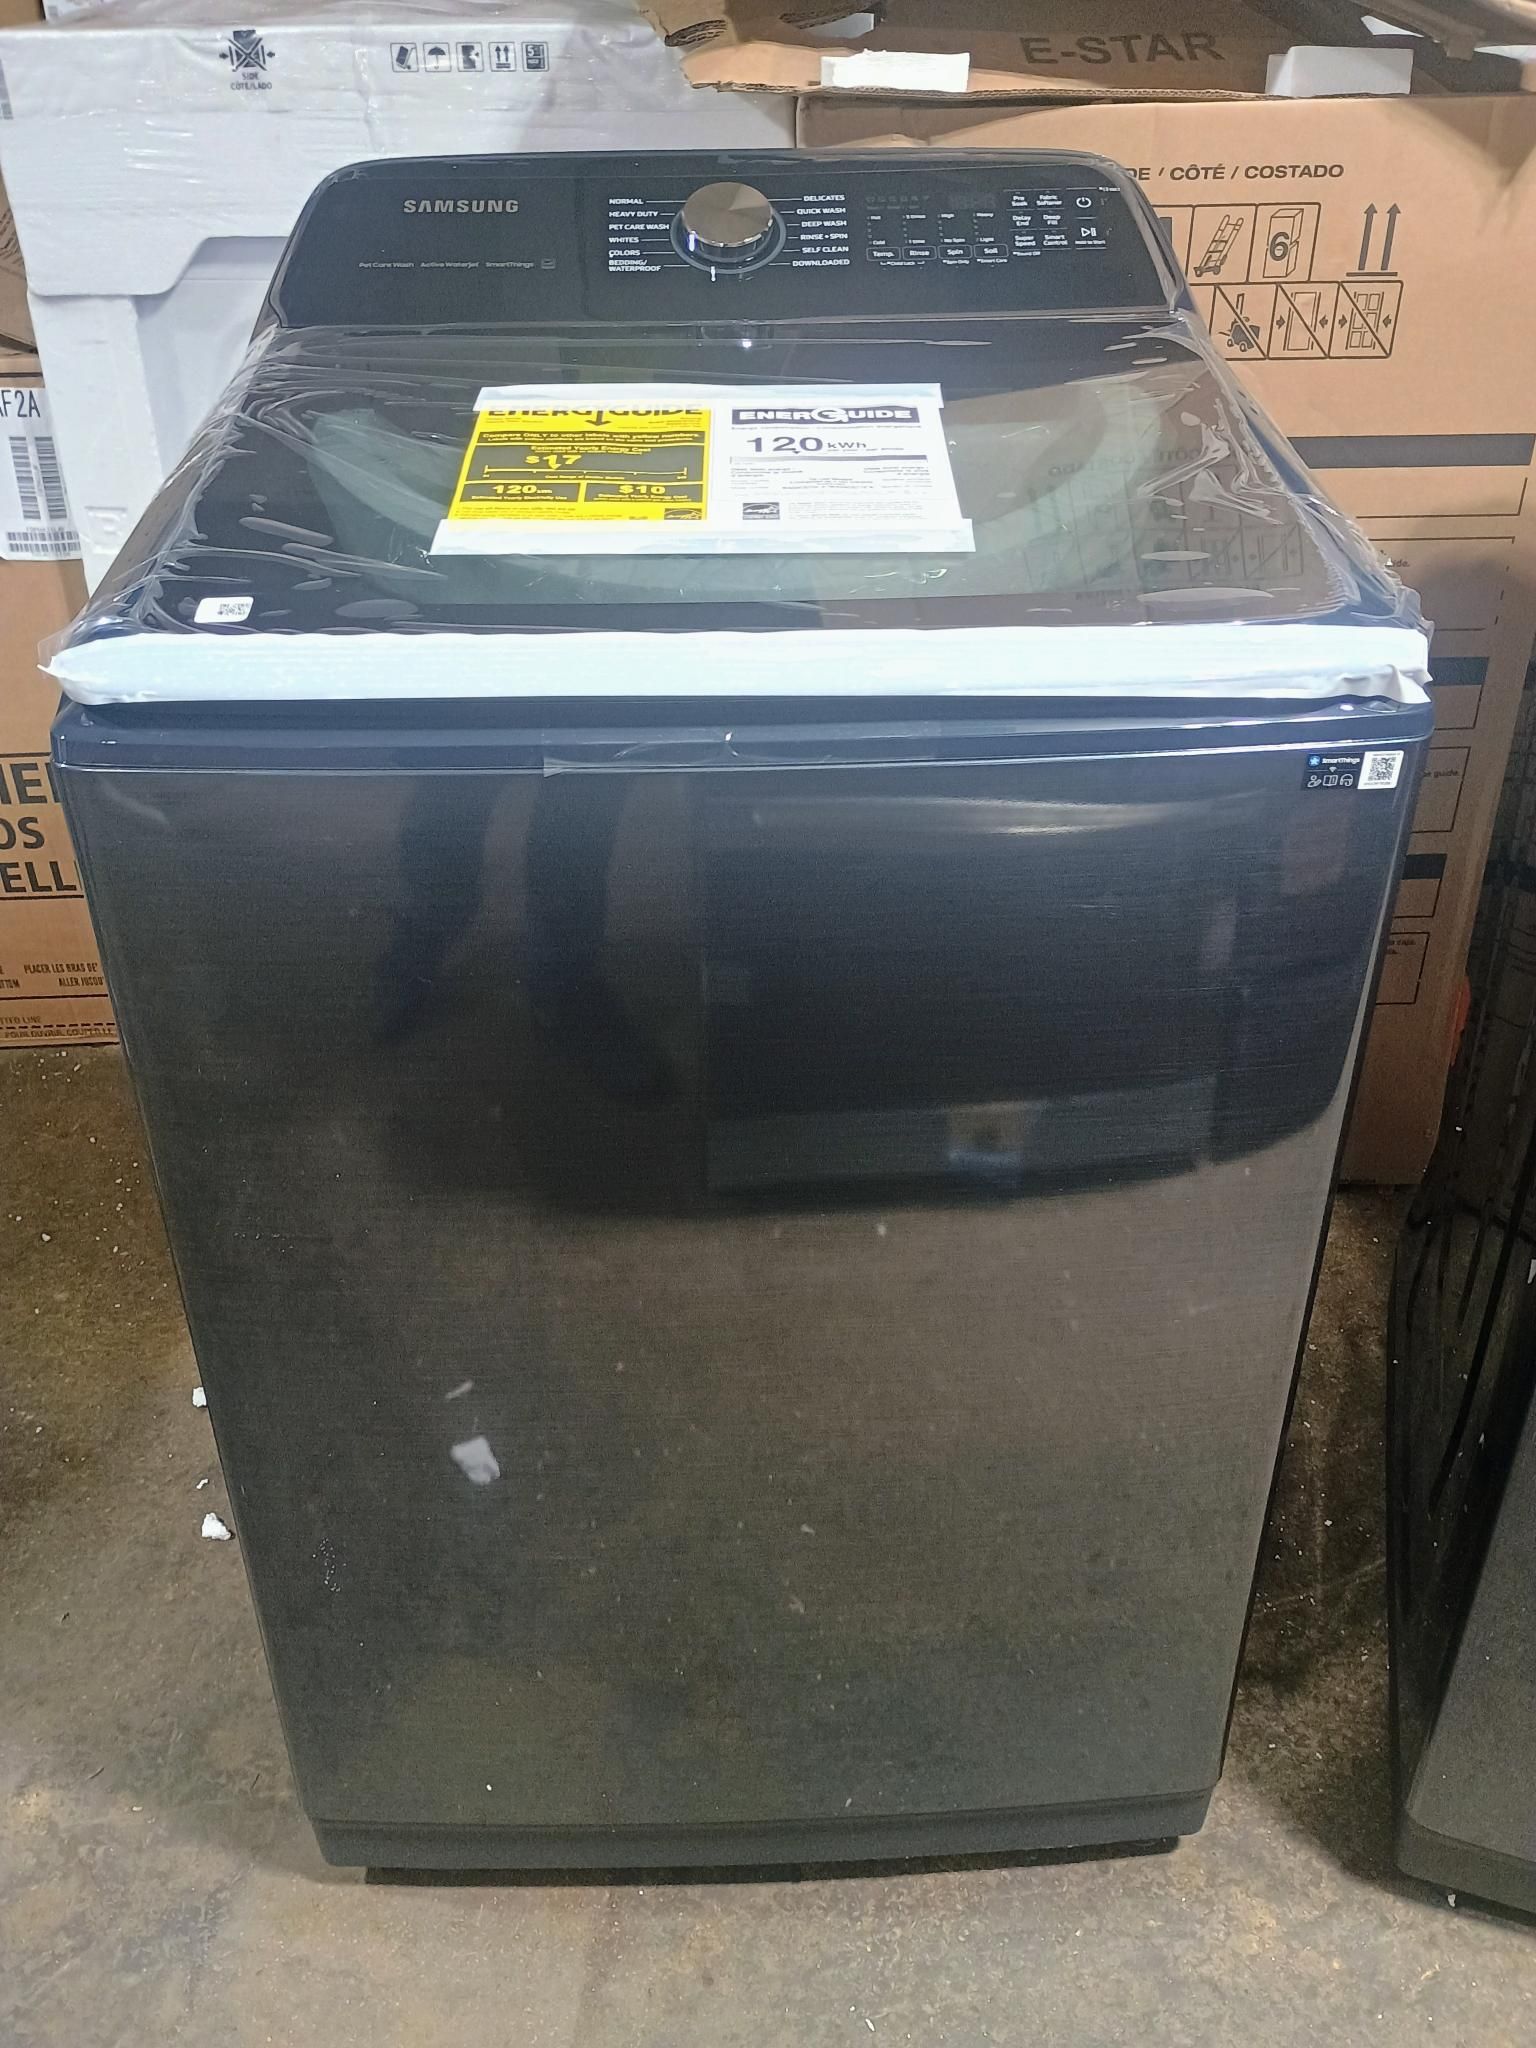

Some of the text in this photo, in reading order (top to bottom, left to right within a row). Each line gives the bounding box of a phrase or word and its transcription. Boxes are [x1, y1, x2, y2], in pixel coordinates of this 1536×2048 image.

[1020, 33, 1226, 66] E-STAR
[1169, 163, 1226, 181] CÔTÉ
[1244, 164, 1345, 180] COSTADO
[803, 194, 845, 202] DELICATES
[403, 199, 519, 213] SAMSUNG
[1269, 232, 1290, 261] 6
[792, 259, 850, 267] DOWNLOADED
[746, 436, 823, 452] 120
[492, 484, 537, 494] 120
